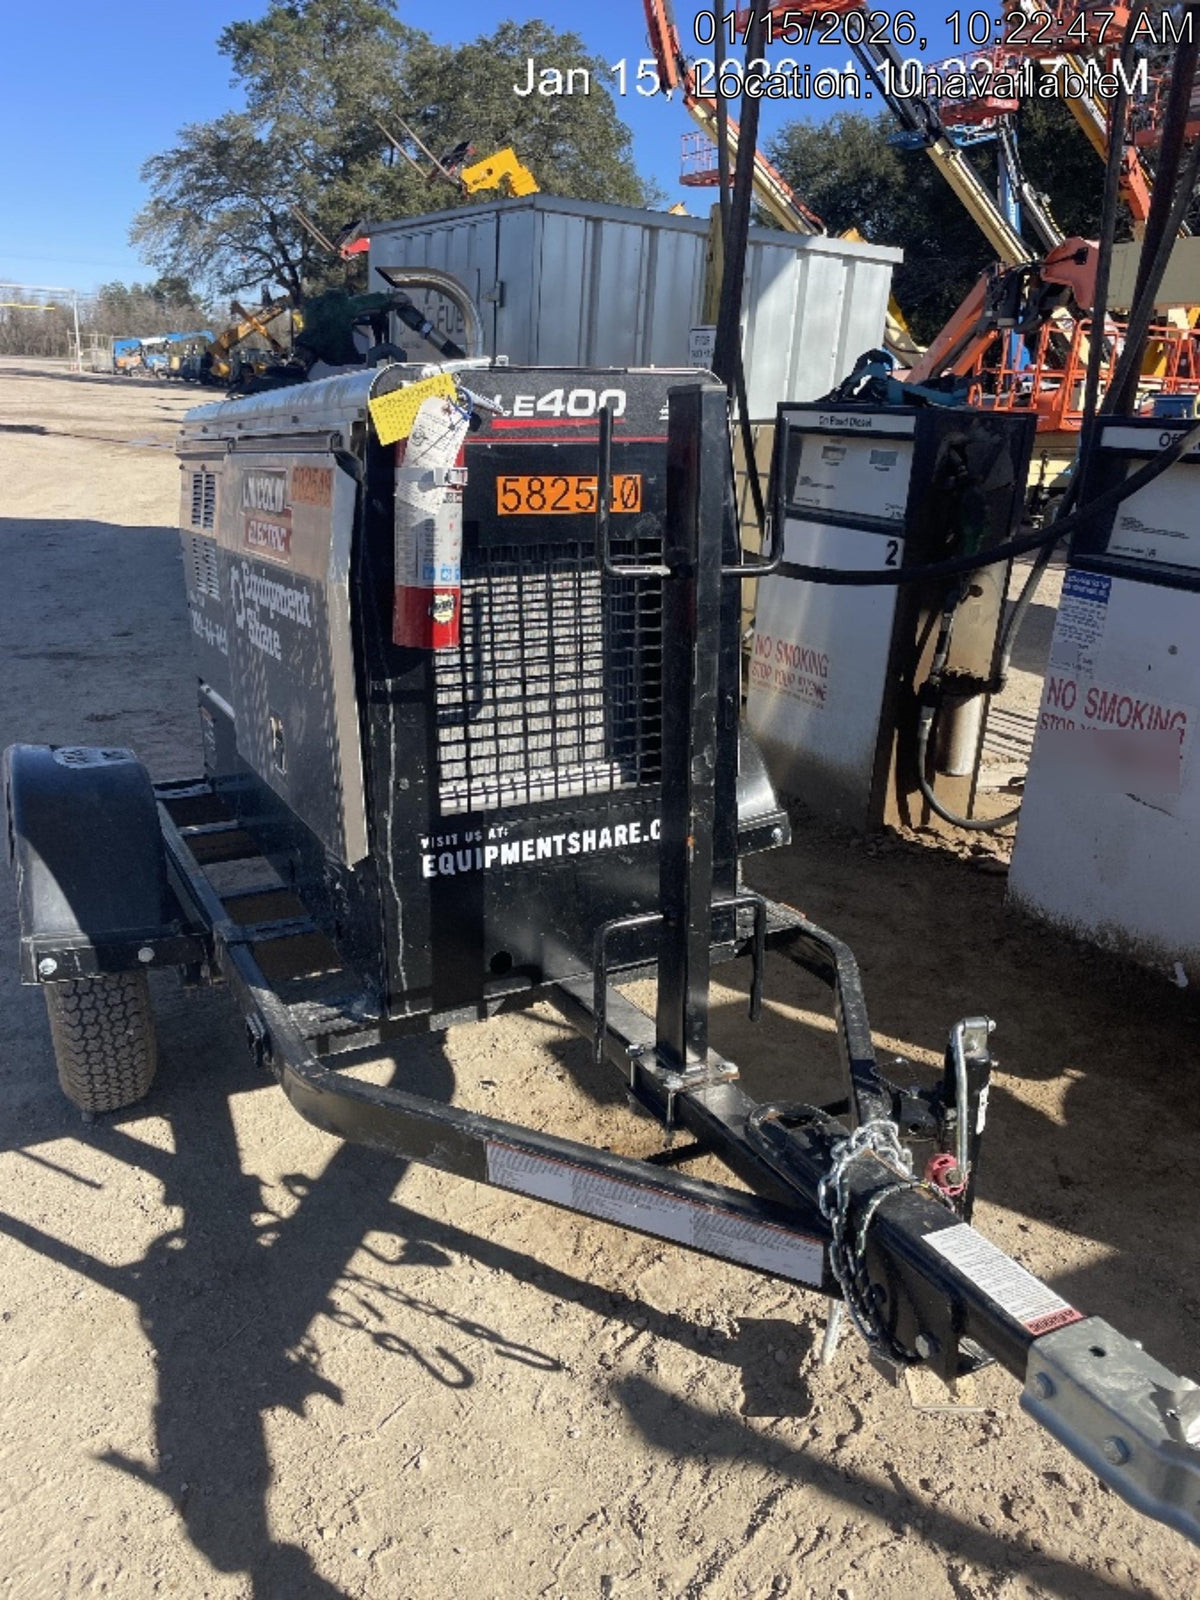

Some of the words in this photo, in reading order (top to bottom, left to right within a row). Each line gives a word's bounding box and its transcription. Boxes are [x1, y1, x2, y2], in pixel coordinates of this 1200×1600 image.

[501, 476, 640, 512] 58250
[885, 540, 899, 566] 2
[755, 634, 772, 659] NO
[775, 640, 830, 678] SMOKING
[1047, 676, 1077, 711] NO
[421, 832, 458, 849] VISIT
[465, 831, 483, 843] US
[488, 826, 509, 840] AT:
